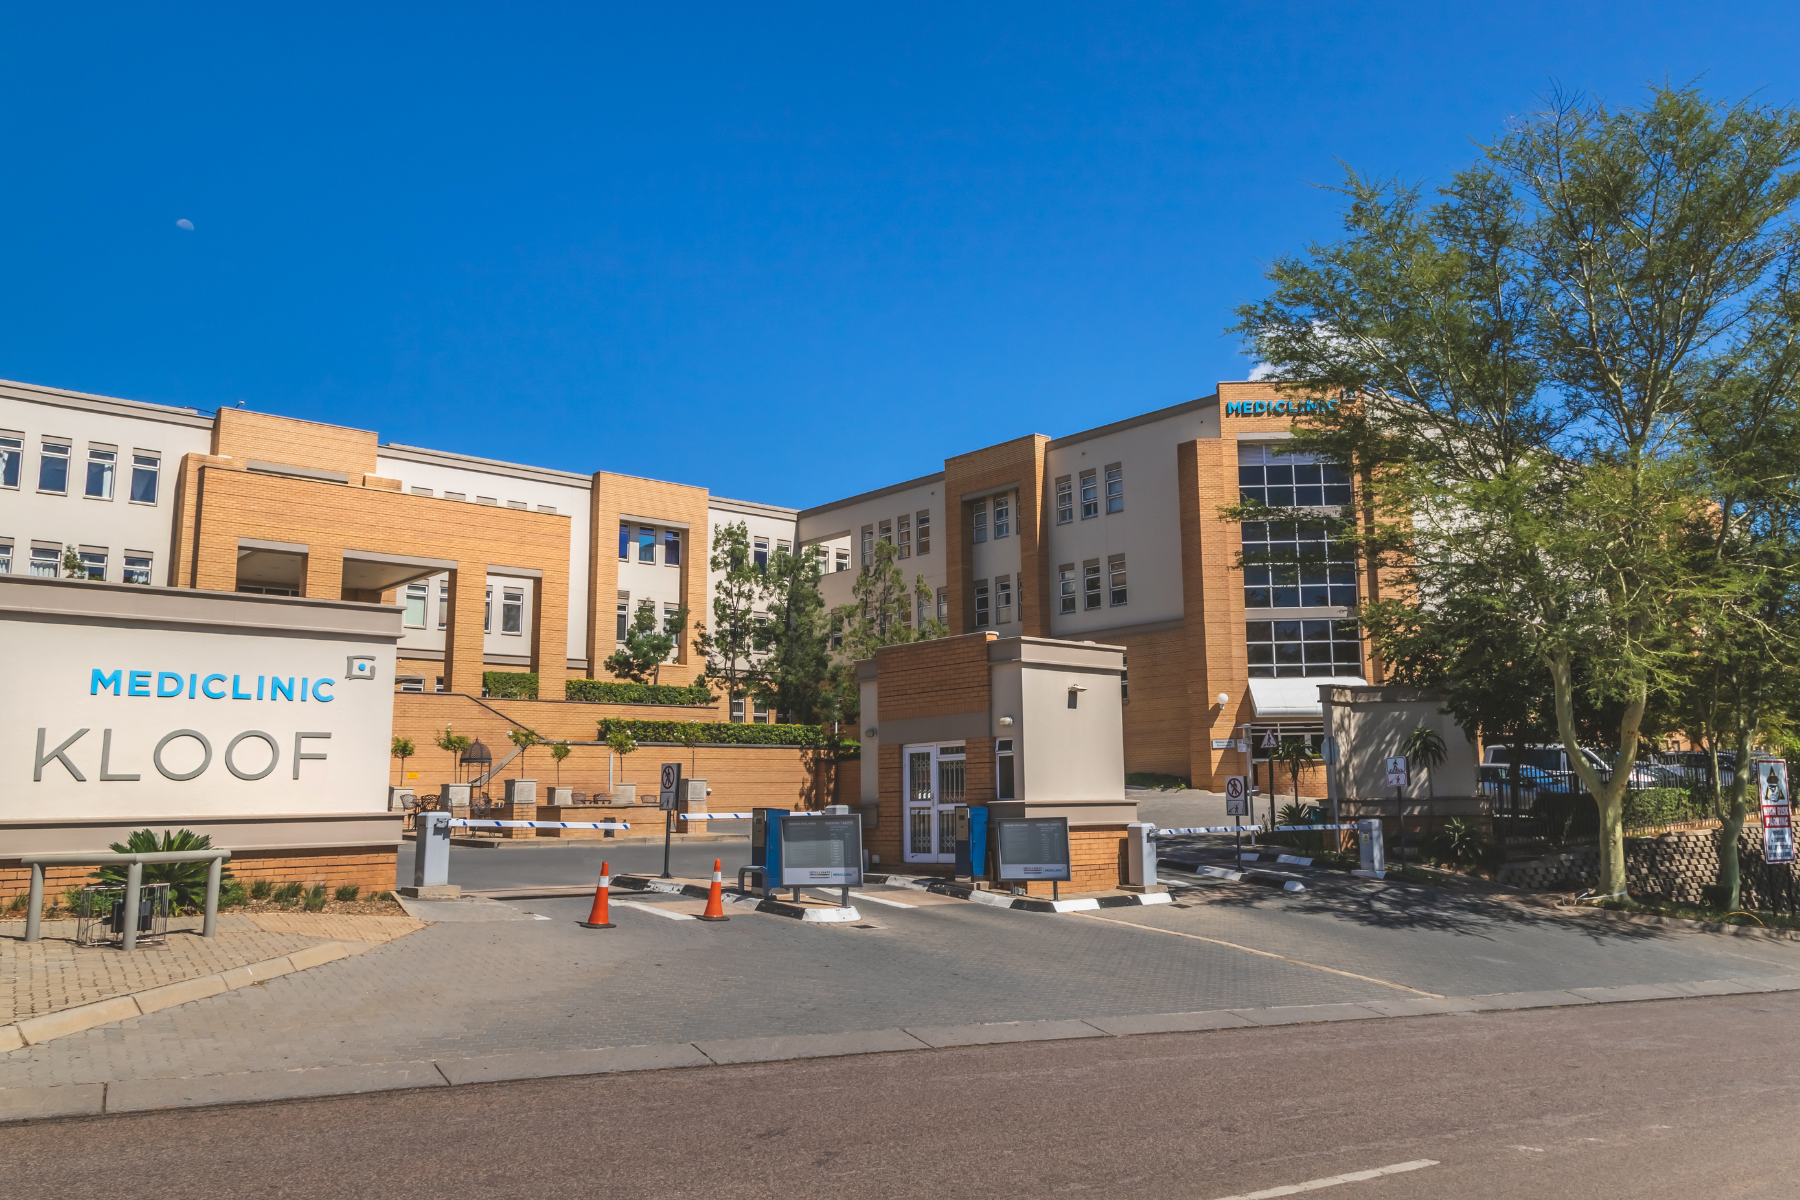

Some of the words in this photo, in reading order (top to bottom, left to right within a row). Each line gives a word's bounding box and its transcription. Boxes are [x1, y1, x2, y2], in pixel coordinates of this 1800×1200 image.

[1228, 399, 1339, 414] MEDICLINIC
[90, 668, 335, 702] MEDICLINIC
[33, 727, 332, 782] KLOOF
[1763, 806, 1776, 816] HIGH
[1777, 806, 1788, 815] RISK
[1766, 817, 1788, 826] PARKING
